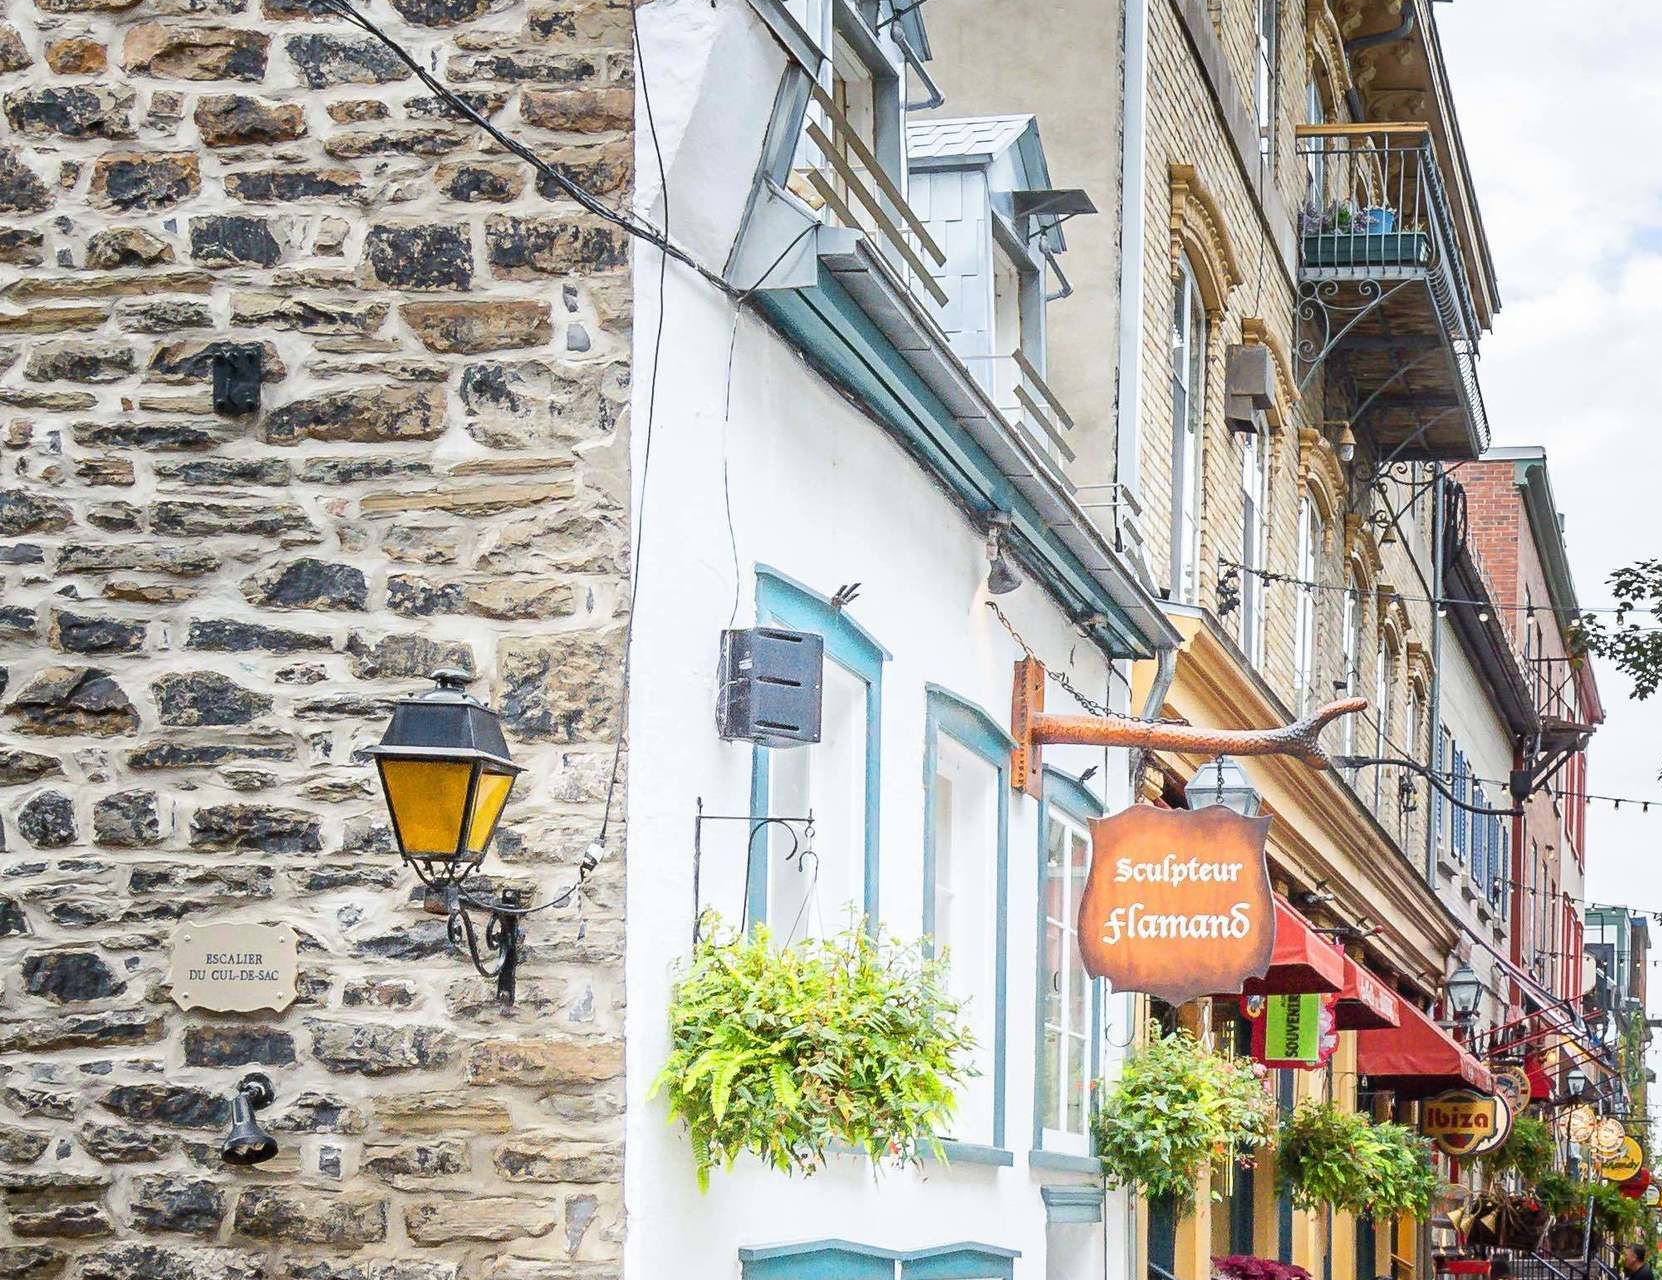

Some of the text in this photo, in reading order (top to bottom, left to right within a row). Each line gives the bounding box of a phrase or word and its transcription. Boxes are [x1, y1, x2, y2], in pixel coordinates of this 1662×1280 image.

[1114, 854, 1243, 888] Sculpteur
[206, 953, 263, 965] ESCALIER
[189, 969, 280, 981] DU CUL-DE-SAC
